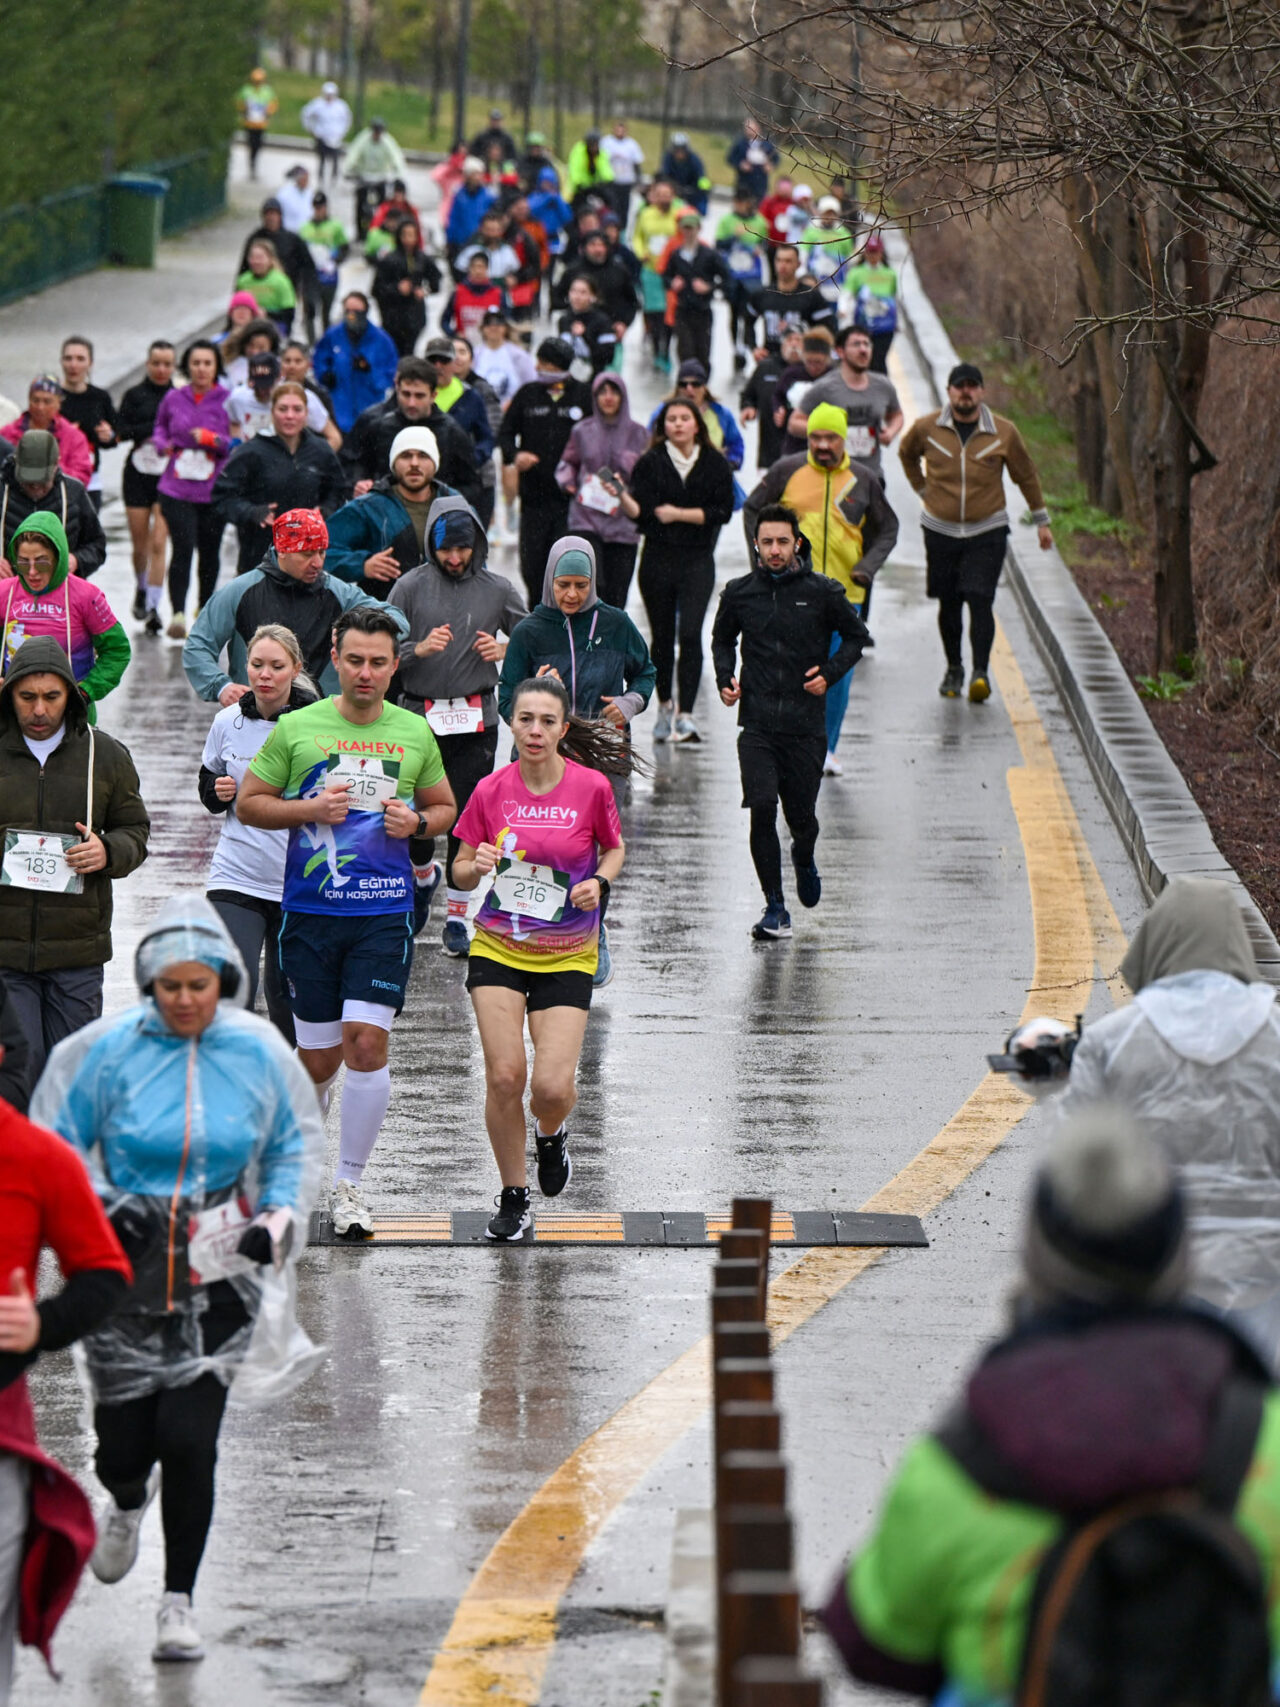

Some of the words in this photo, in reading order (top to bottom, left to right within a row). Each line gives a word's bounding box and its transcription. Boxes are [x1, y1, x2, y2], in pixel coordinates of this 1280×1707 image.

[21, 603, 63, 614] KAHEV
[440, 713, 469, 726] 1018
[337, 740, 397, 755] KAHEV
[345, 778, 377, 796] 215
[517, 805, 571, 820] KAHEV
[24, 857, 57, 875] 183
[359, 876, 406, 889] EĞİTİM
[513, 882, 547, 903] 216
